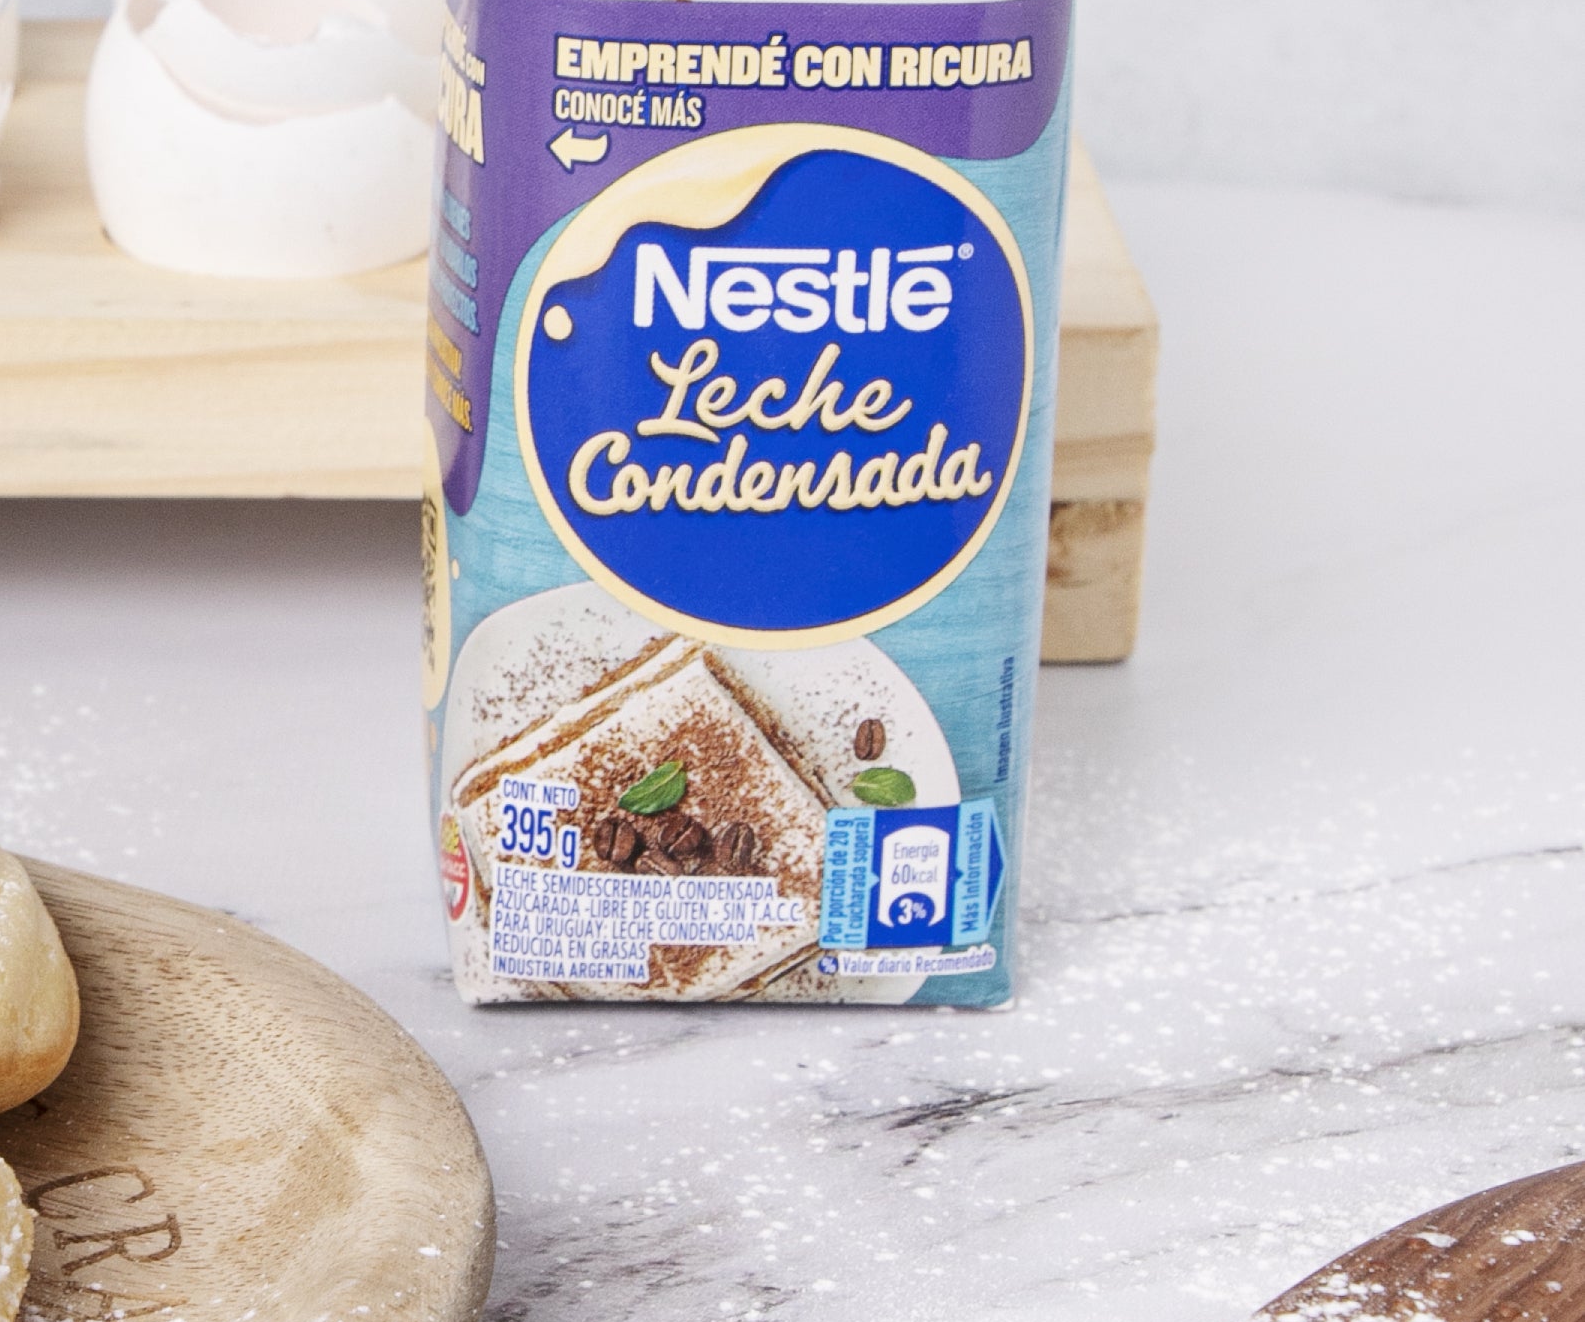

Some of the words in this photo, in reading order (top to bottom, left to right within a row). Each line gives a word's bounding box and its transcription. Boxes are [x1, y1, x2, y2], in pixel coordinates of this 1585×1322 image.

[555, 36, 785, 87] EMPRENDÉ
[794, 45, 885, 87] CON
[890, 38, 1033, 87] RICURA
[555, 89, 645, 125] CONOCÉ
[650, 90, 702, 127] MÁS
[637, 338, 912, 442] Leche
[568, 424, 993, 514] Condensada
[503, 779, 540, 804] CONT.
[543, 785, 577, 807] NETO
[501, 803, 553, 856] 395
[561, 830, 577, 869] g
[834, 818, 855, 828] g
[829, 830, 850, 847] 20
[893, 840, 939, 862] Energía
[964, 811, 983, 895] Información
[828, 850, 847, 867] de
[497, 867, 538, 892] LECHE
[542, 873, 671, 900] SEMIDESCREMADA
[677, 880, 774, 901] CONDENSADA
[824, 869, 847, 918] porción
[846, 866, 865, 929] cucharada
[496, 889, 580, 917] AZUCARADA
[633, 900, 649, 920] DE
[655, 900, 709, 921] GLUTEN
[723, 902, 746, 921] SIN
[897, 897, 927, 925] 3%
[960, 903, 978, 933] Más
[495, 910, 530, 933] PARA
[535, 916, 608, 939] URUGUAY:
[612, 920, 653, 940] LECHE
[658, 922, 756, 941] CONDENSADA
[822, 922, 842, 943] Por
[493, 931, 563, 957] REDUCIDA
[568, 939, 586, 959] EN
[591, 940, 646, 960] GRASAS
[493, 955, 564, 977] INDUSTRIA
[569, 962, 646, 979] ARGENTINA
[842, 955, 874, 973] Valor
[877, 956, 911, 974] diario
